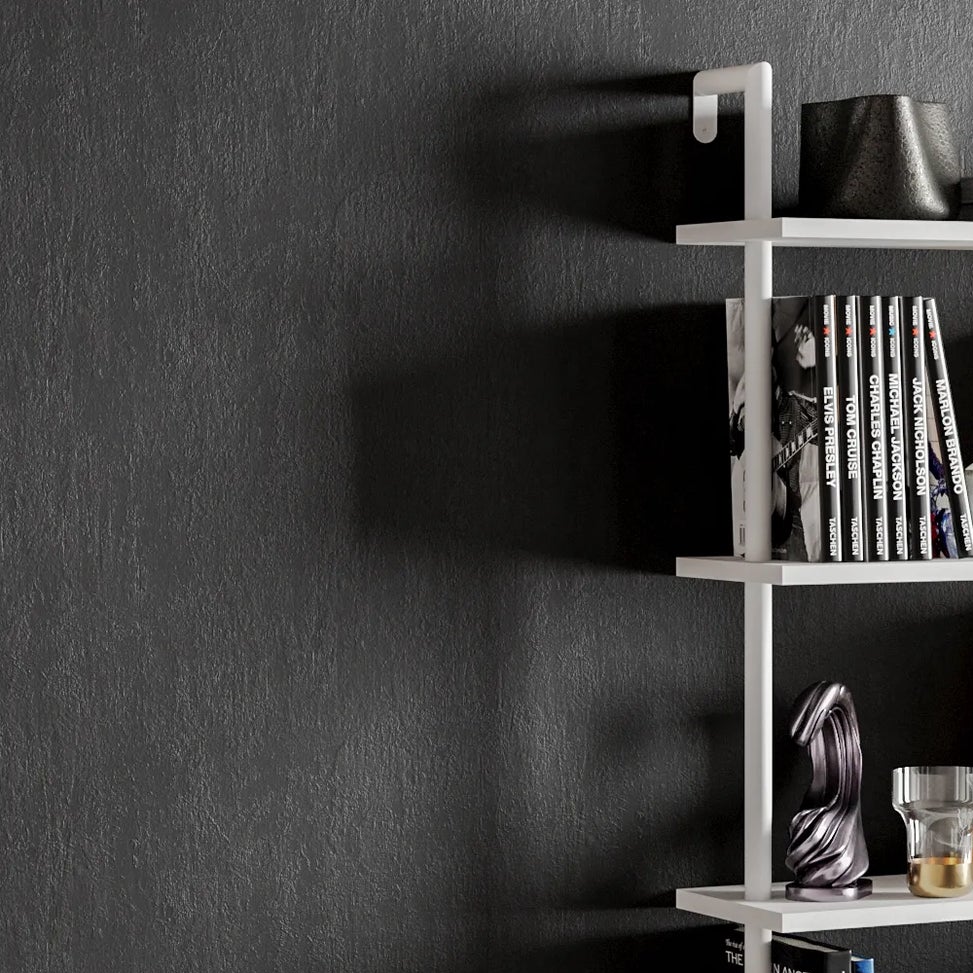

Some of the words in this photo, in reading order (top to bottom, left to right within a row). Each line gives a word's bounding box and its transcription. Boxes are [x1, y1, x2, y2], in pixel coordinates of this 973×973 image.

[823, 387, 834, 424] ELVIS
[846, 395, 857, 426] TOM
[869, 374, 881, 439] CHARLES
[889, 373, 900, 434] MICHAEL
[912, 377, 924, 414] JACK
[846, 428, 858, 480] CRUISE
[914, 417, 926, 496] NICHOLSON
[936, 379, 954, 436] MARLON
[945, 439, 963, 495] BRANDO
[824, 428, 837, 488] PRESLEY
[871, 440, 884, 499] CHAPLIN
[891, 437, 903, 500] JACKSON
[829, 517, 837, 556] TASCHEN
[851, 517, 859, 555] TASCHEN
[876, 517, 884, 556] TASCHEN
[895, 516, 904, 555] TASCHEN
[919, 516, 928, 555] TASCHEN
[960, 514, 972, 552] TASCHEN
[725, 950, 744, 966] THE
